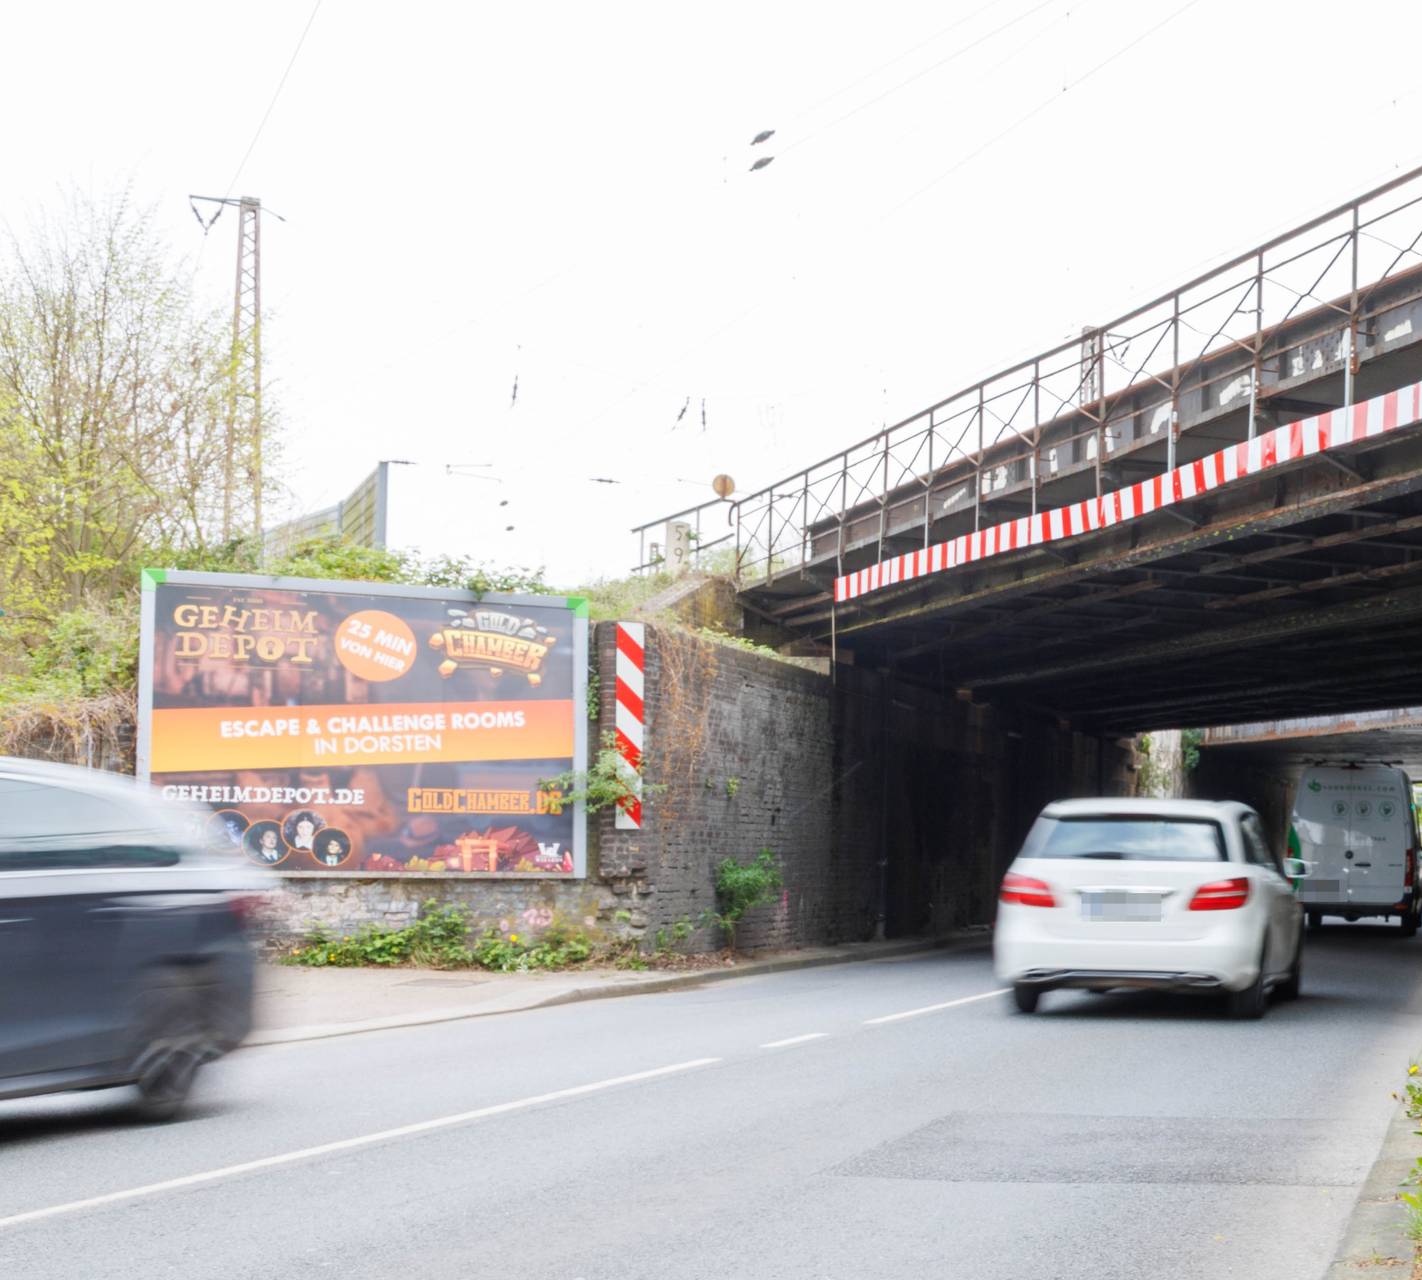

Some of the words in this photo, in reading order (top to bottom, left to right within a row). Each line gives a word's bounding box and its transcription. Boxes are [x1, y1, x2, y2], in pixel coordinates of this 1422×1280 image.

[675, 524, 685, 541] 5
[673, 547, 684, 564] 9
[174, 604, 319, 634] GEHEIM
[475, 611, 521, 635] GOLD
[174, 631, 318, 663] DEPOT
[347, 619, 373, 639] 25
[373, 628, 413, 656] MIN
[443, 629, 548, 671] CHAMBER
[340, 636, 373, 659] VON
[373, 651, 405, 672] HIER
[220, 719, 300, 738] ESCAPE
[306, 718, 321, 735] &
[327, 713, 446, 734] CHALLENGE
[451, 711, 526, 729] ROOMS
[314, 737, 337, 755] IN
[344, 734, 442, 754] DORSTEN
[162, 785, 365, 805] GEHEIMDEPOT.DE
